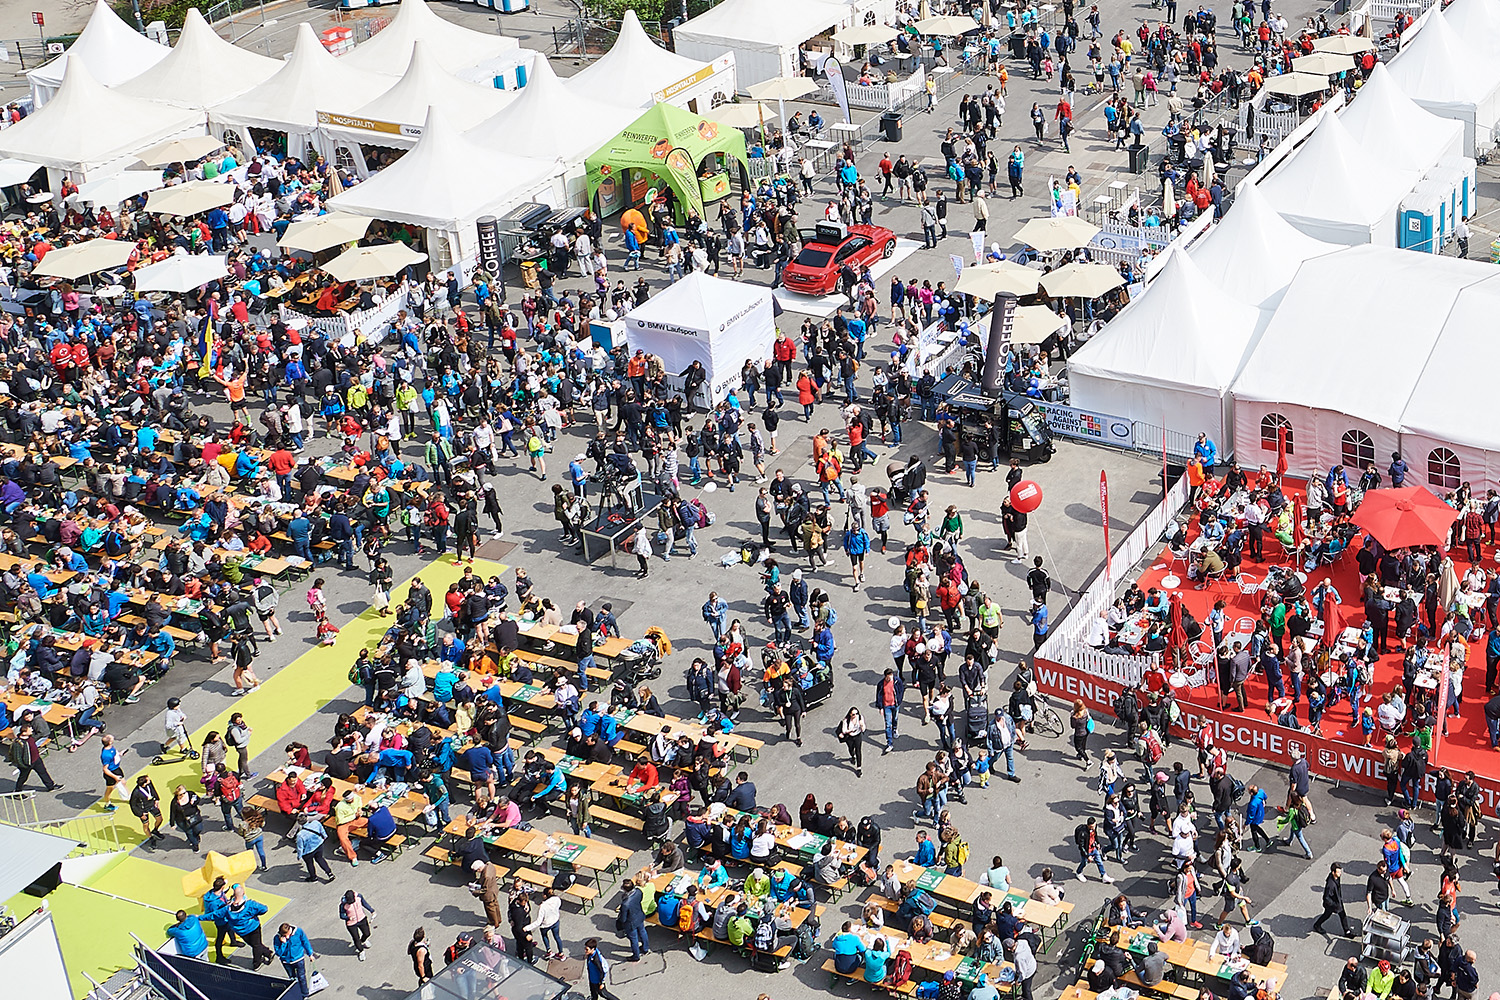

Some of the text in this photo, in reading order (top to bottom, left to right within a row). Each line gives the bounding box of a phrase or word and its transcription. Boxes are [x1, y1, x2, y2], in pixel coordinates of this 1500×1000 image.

[666, 75, 697, 96] HOSPITALITY
[333, 117, 375, 129] HOSPITALITY
[622, 131, 658, 142] REINWERFEN
[726, 298, 763, 327] BMW Laufsport
[647, 322, 698, 337] BMW Laufsport
[998, 308, 1016, 367] COFFEE
[721, 372, 737, 390] BMW
[1047, 407, 1073, 419] RACING
[1054, 414, 1082, 427] AGAINST
[1047, 420, 1079, 433] POVERTY
[1341, 753, 1438, 794] WIER
